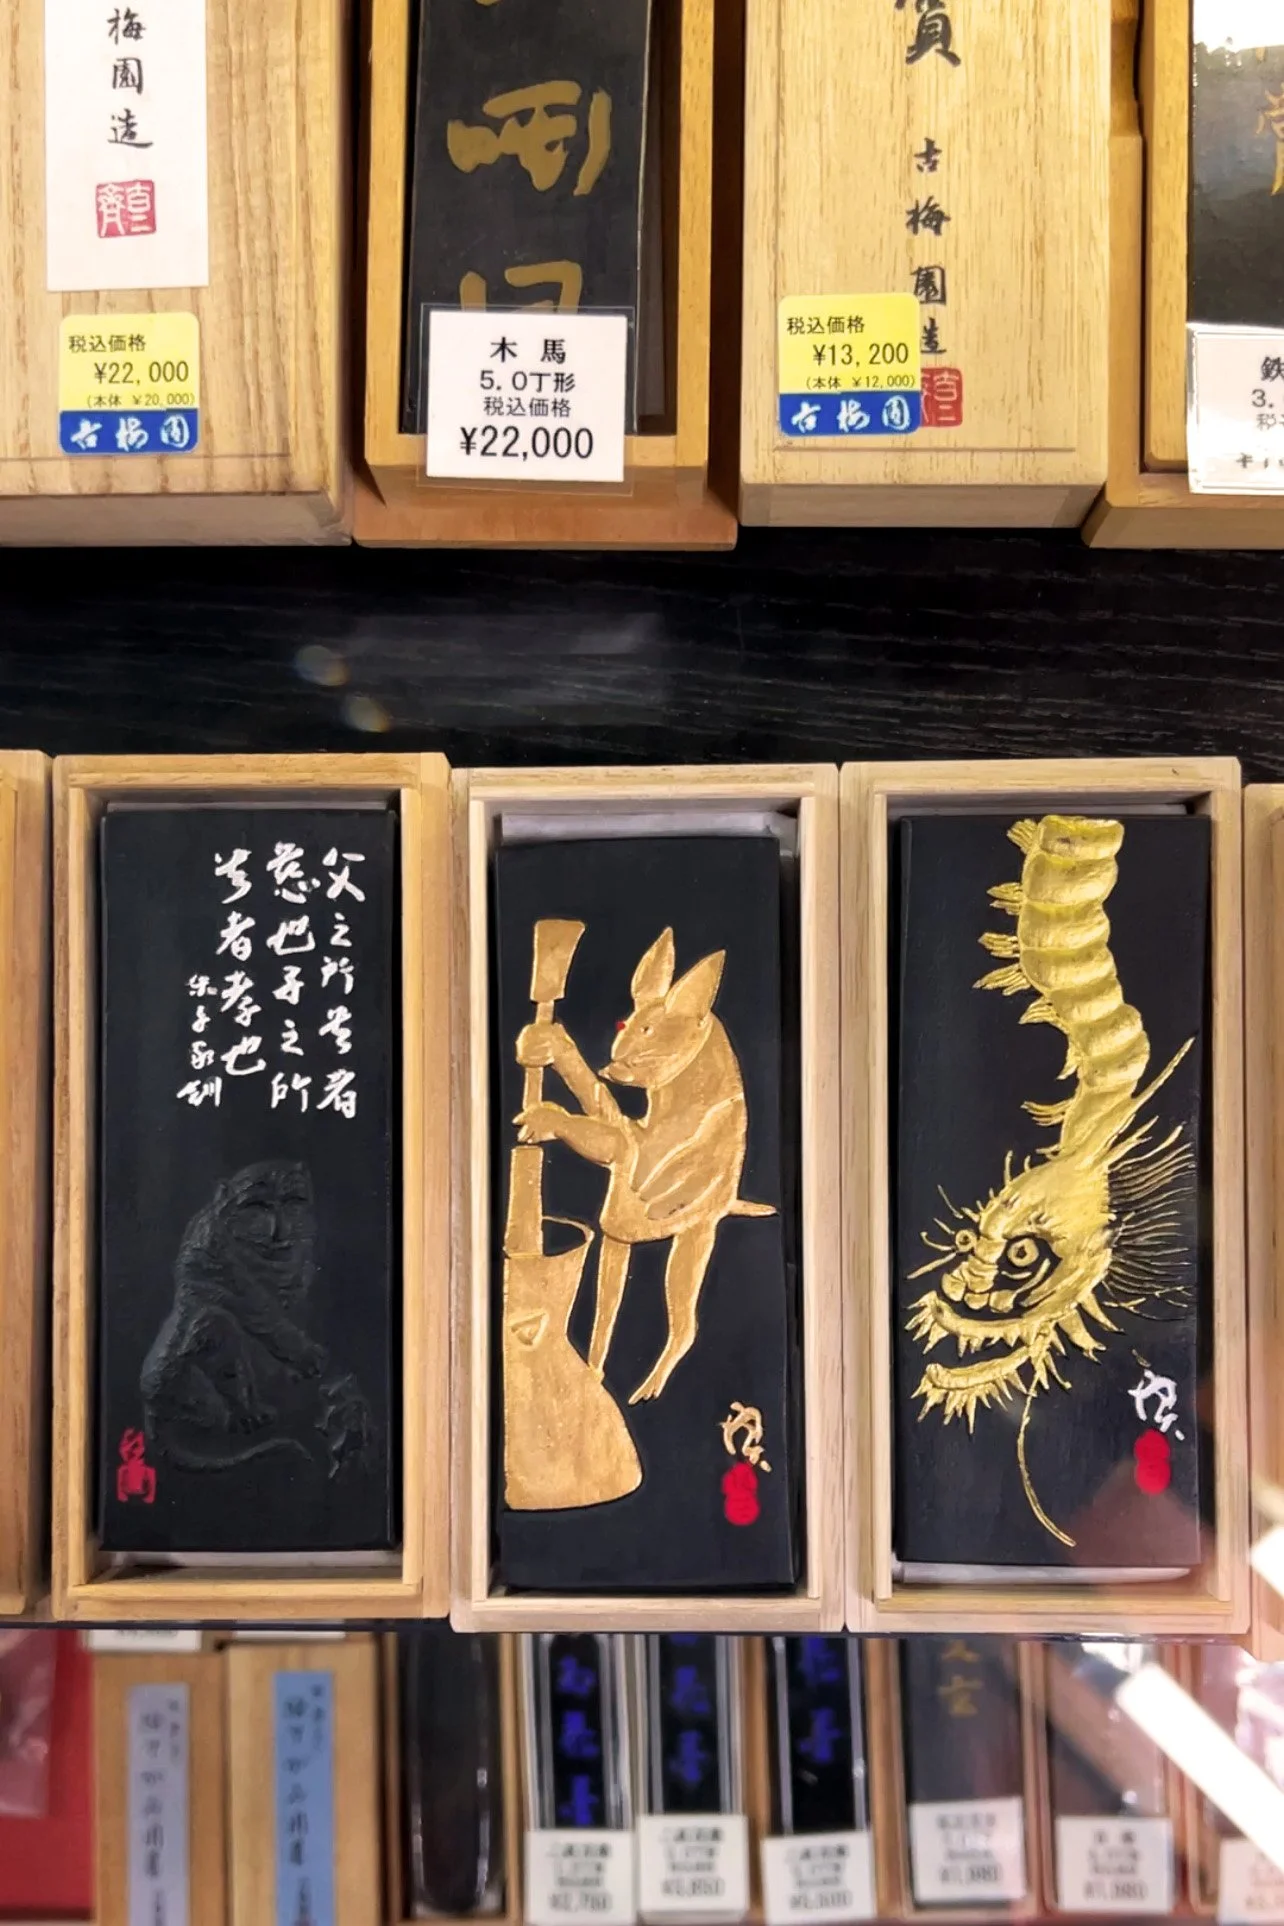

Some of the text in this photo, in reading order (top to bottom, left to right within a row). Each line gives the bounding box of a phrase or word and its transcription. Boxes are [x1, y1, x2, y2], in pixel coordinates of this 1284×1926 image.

[786, 316, 865, 335] 税込価格
[68, 334, 146, 353] 税込価格
[812, 343, 909, 367] ¥13,200
[94, 361, 189, 386] ¥22,000
[483, 396, 571, 418] 税込価格
[460, 425, 594, 462] ¥22,000
